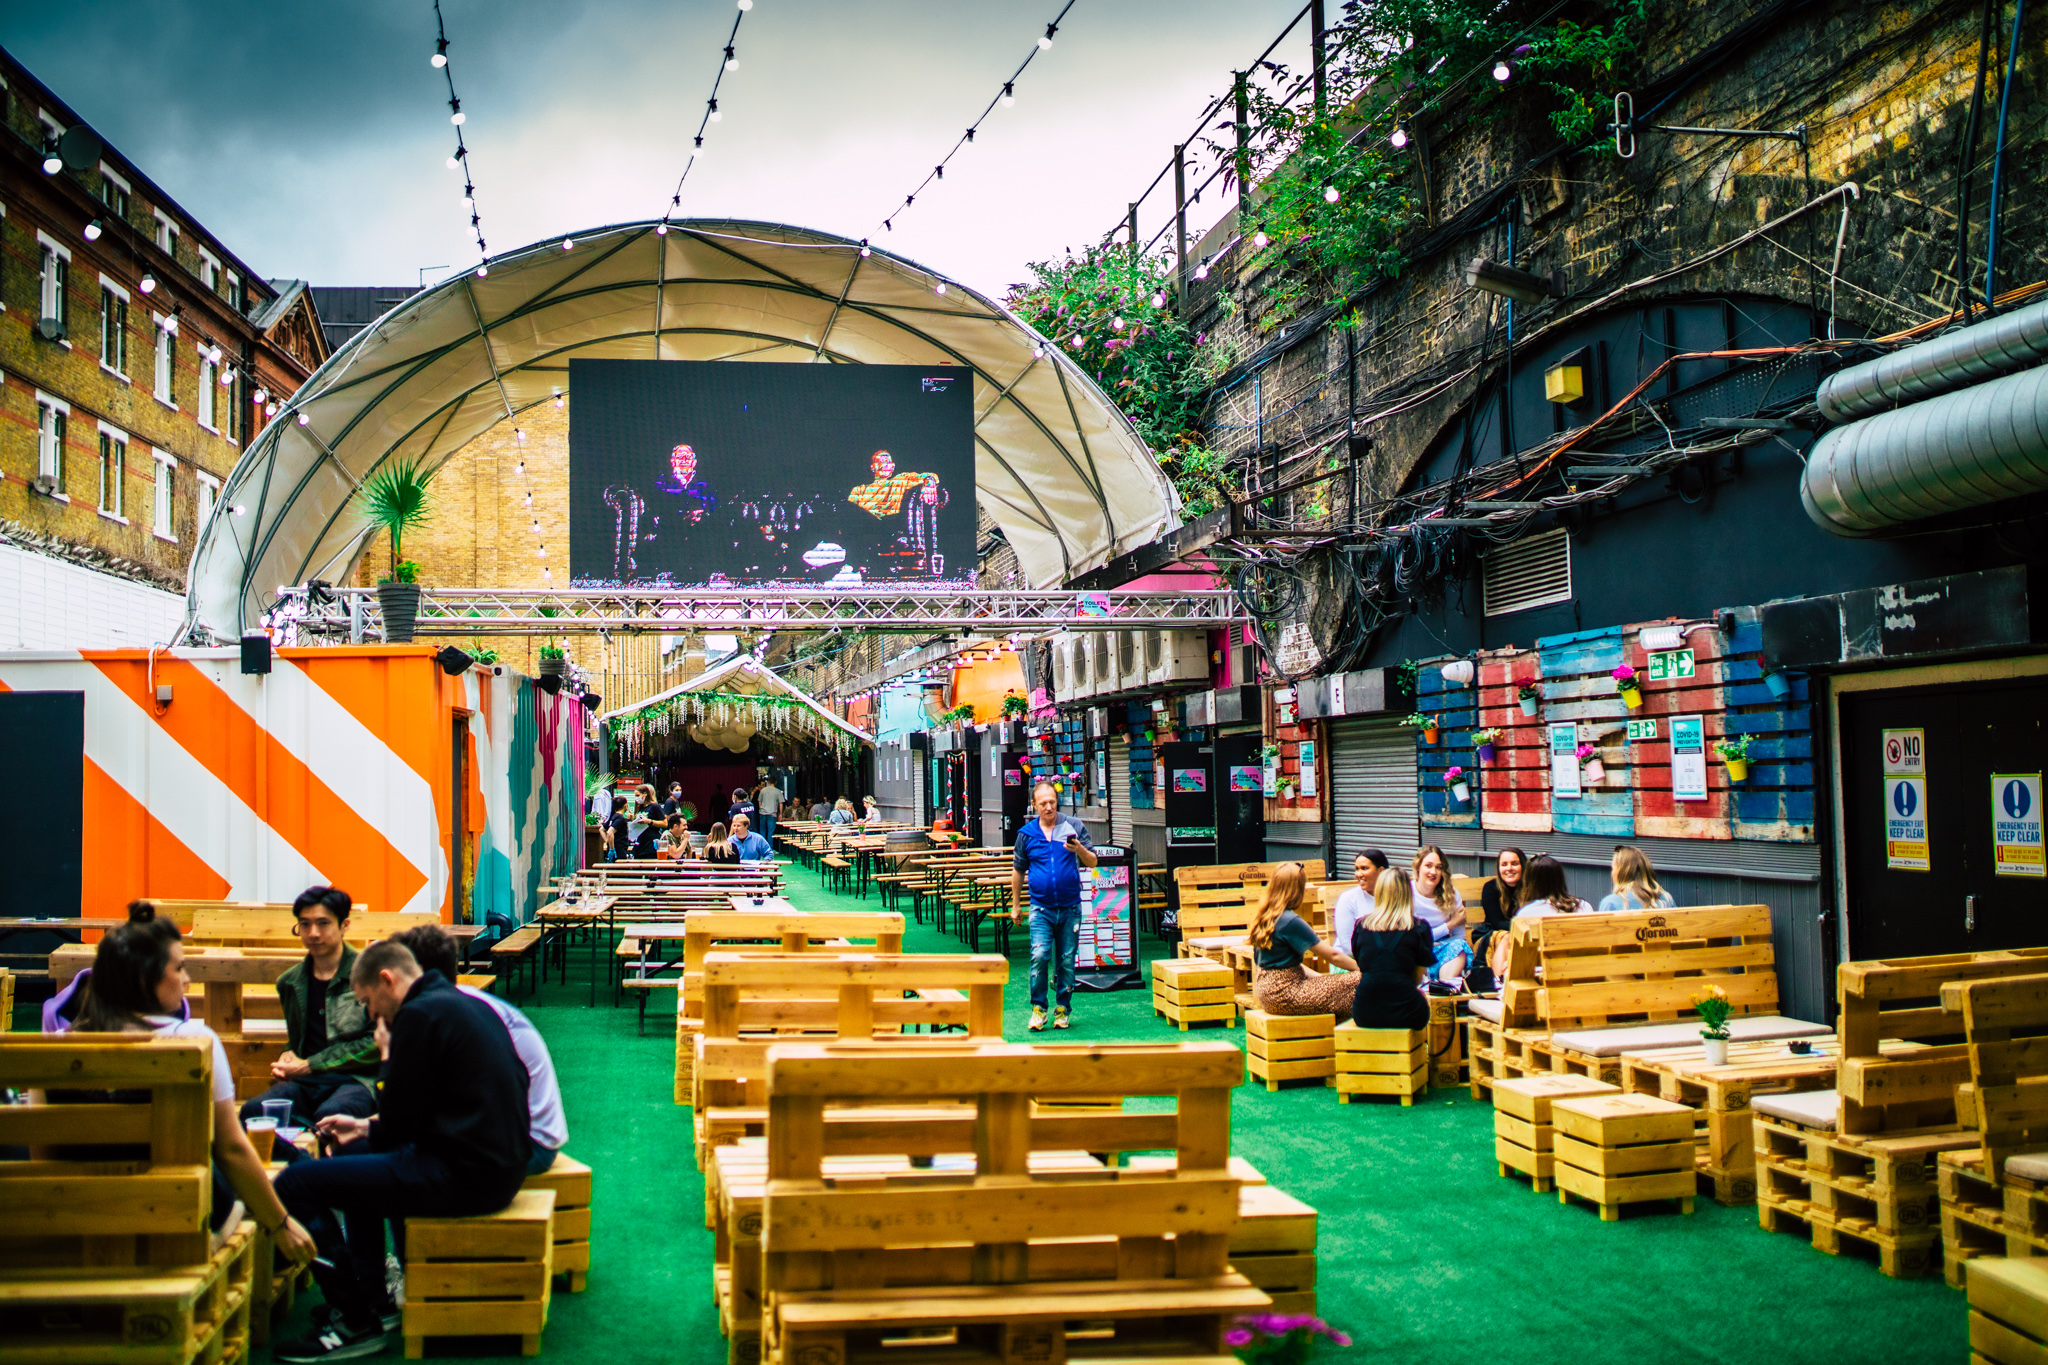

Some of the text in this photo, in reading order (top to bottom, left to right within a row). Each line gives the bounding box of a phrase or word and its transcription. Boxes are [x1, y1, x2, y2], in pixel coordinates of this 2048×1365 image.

[1651, 656, 1664, 666] Fire
[1651, 667, 1664, 677] exit
[1676, 731, 1699, 739] COVID-19
[1903, 736, 1921, 757] NO
[1904, 757, 1921, 766] ENTRY
[1889, 820, 1924, 828] EMERGENCY EXIT
[1997, 821, 2039, 831] EMERGENCY EXIT
[1889, 828, 1925, 839] KEEP CLEAR
[1997, 831, 2040, 843] KEEP CLEAR
[1238, 872, 1266, 880] Corona
[1635, 927, 1678, 942] Corona
[318, 1332, 342, 1350] N
